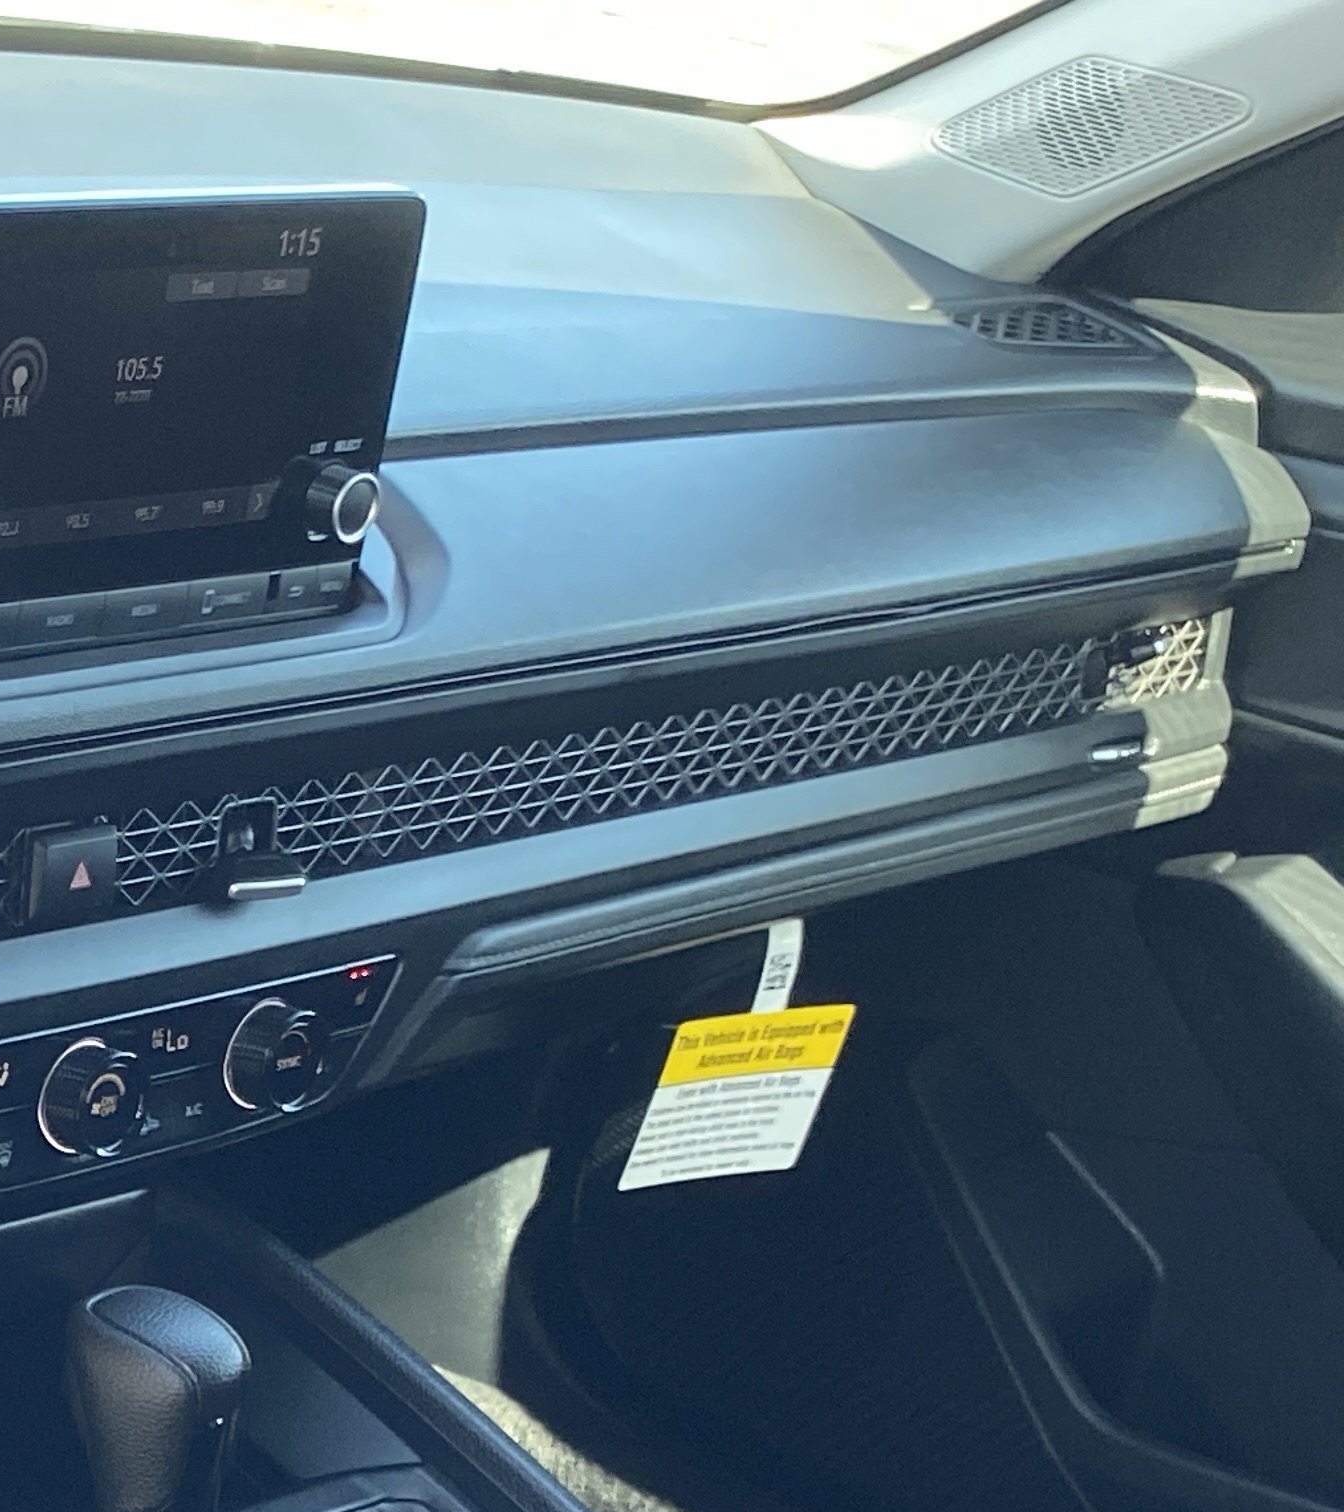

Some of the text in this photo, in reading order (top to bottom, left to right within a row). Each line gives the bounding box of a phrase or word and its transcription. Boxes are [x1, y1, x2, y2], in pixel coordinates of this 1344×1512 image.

[279, 227, 324, 257] 1:15
[116, 355, 163, 382] 105.5
[2, 395, 29, 418] FM
[678, 1036, 700, 1049] This
[704, 1030, 745, 1046] Vehicle
[762, 1022, 817, 1041] Equipped
[697, 1050, 753, 1068] Advanced
